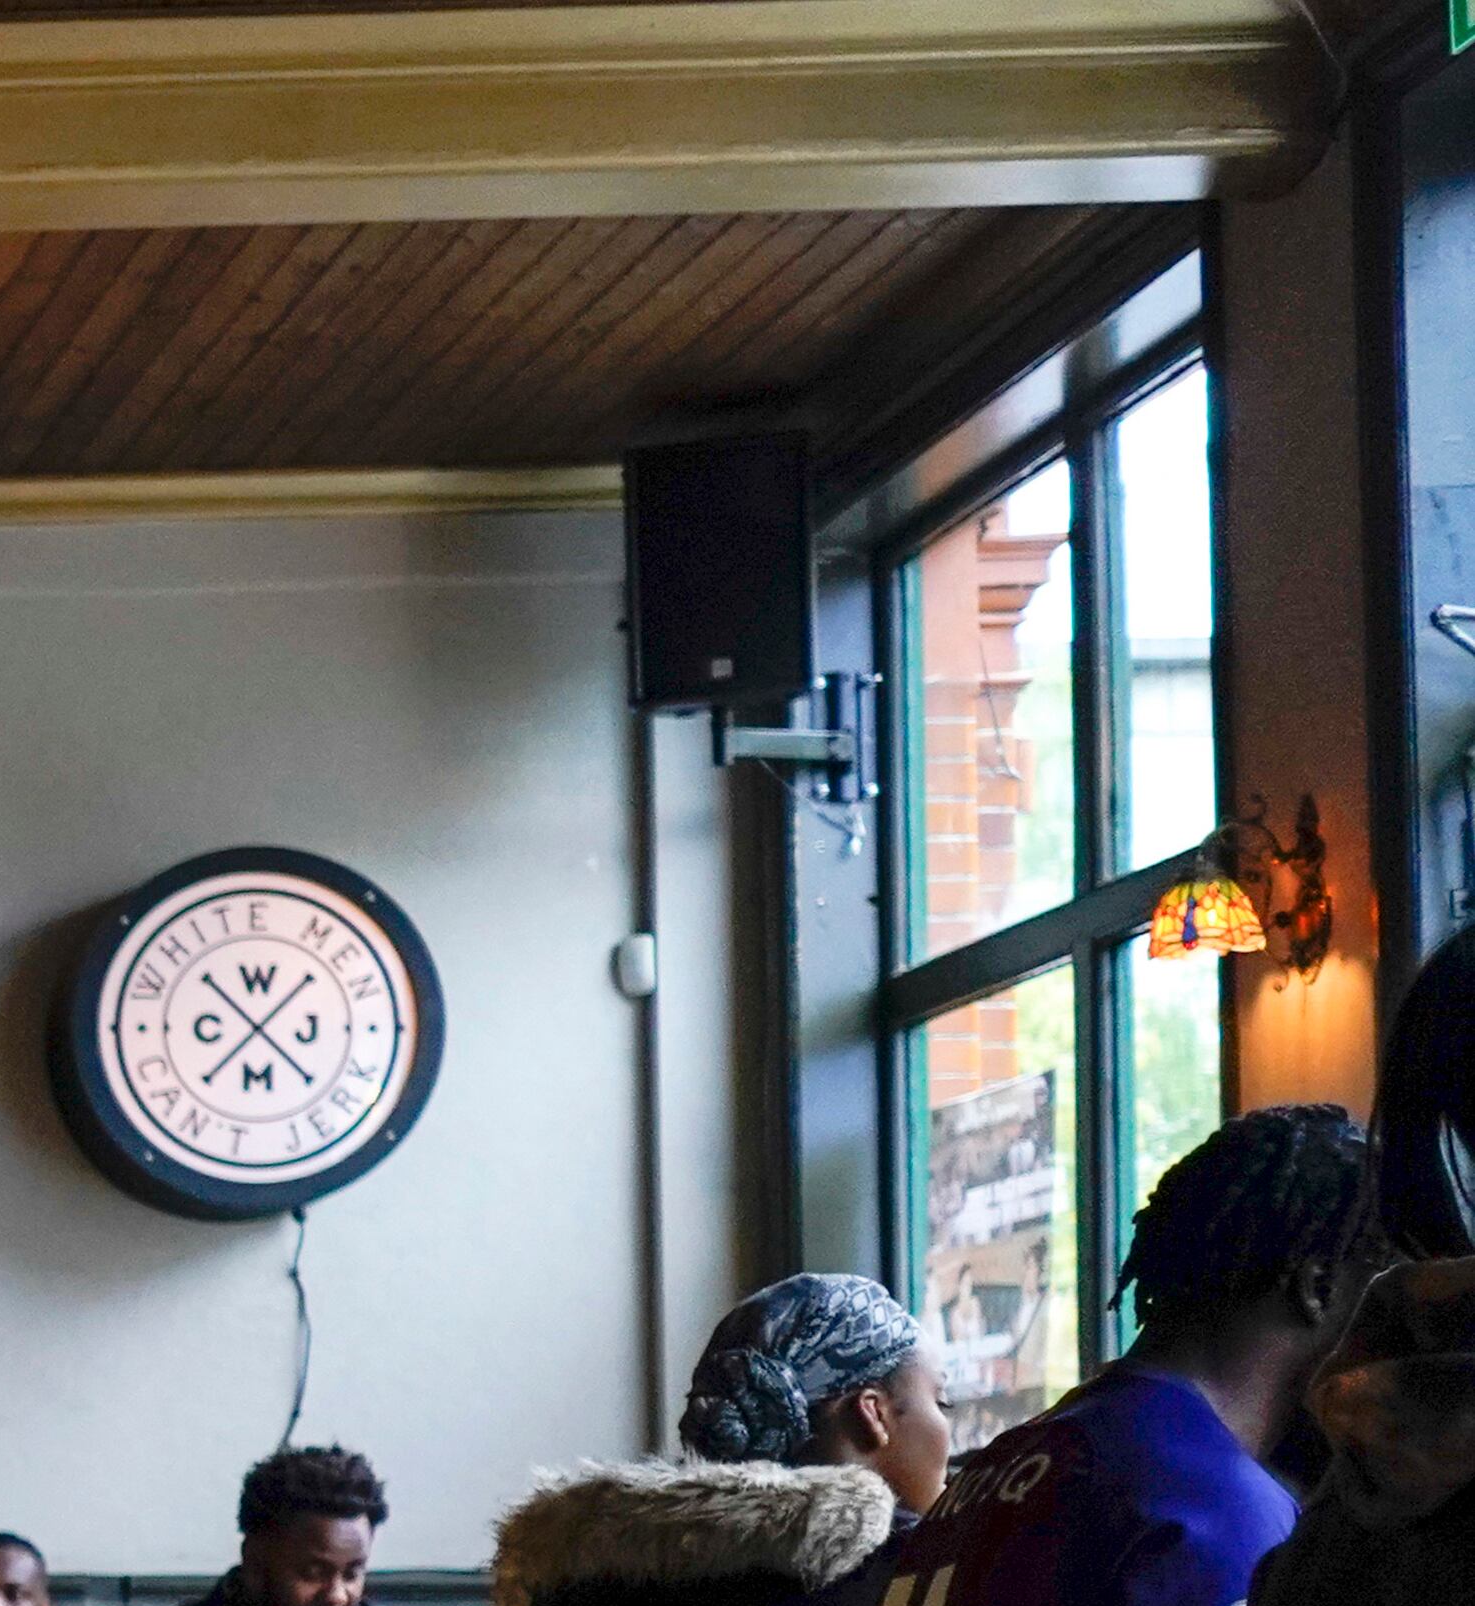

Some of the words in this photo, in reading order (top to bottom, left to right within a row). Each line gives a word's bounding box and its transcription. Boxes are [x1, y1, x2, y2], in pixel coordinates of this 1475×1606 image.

[131, 902, 269, 1001] WHITE
[239, 963, 277, 996] W
[298, 914, 382, 1002] MEN
[193, 1013, 223, 1043] C
[294, 1014, 320, 1044] J
[135, 1053, 250, 1156] CAN'T
[241, 1062, 274, 1092] M
[284, 1056, 379, 1154] JERK
